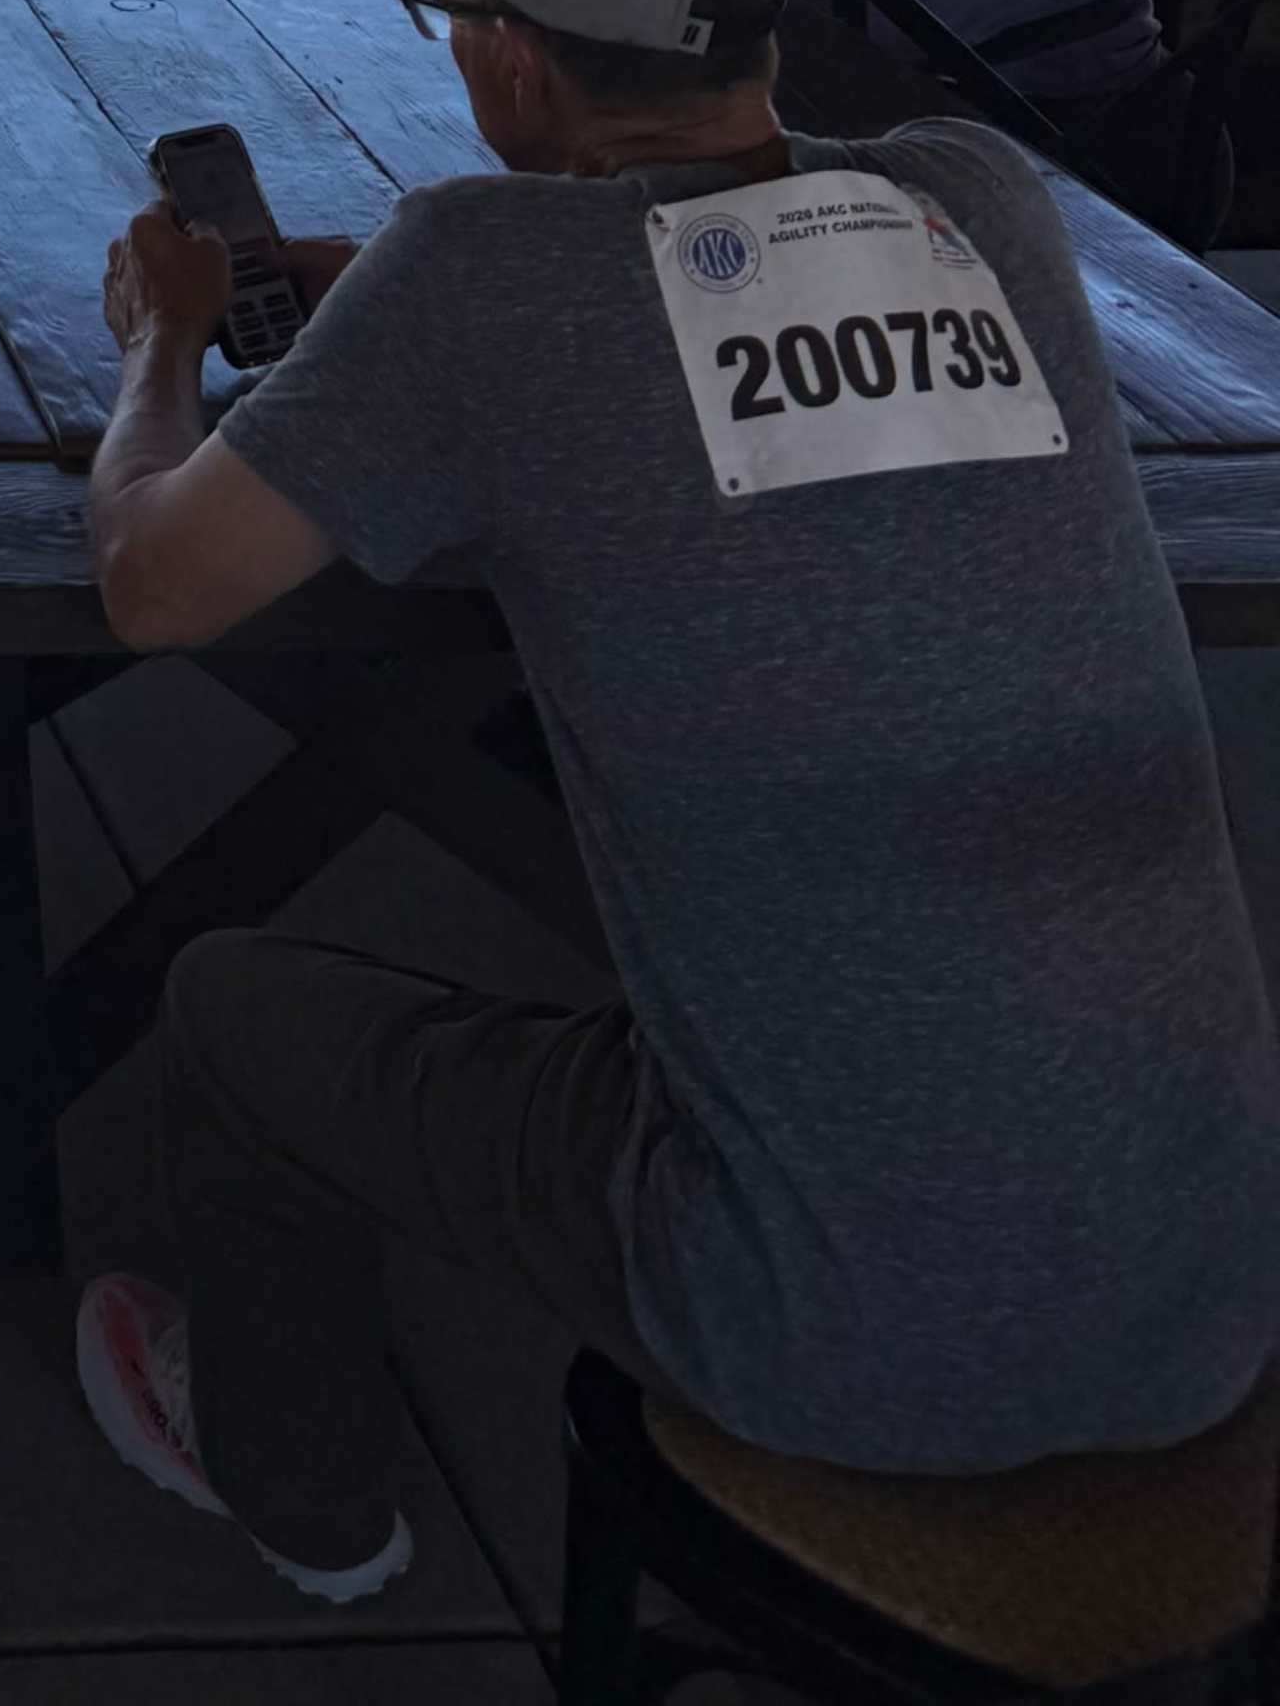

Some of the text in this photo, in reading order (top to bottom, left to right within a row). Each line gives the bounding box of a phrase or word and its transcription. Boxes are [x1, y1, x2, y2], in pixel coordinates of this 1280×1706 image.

[817, 203, 848, 218] AKC
[768, 223, 828, 245] AGILITY
[716, 308, 1022, 422] 200739
